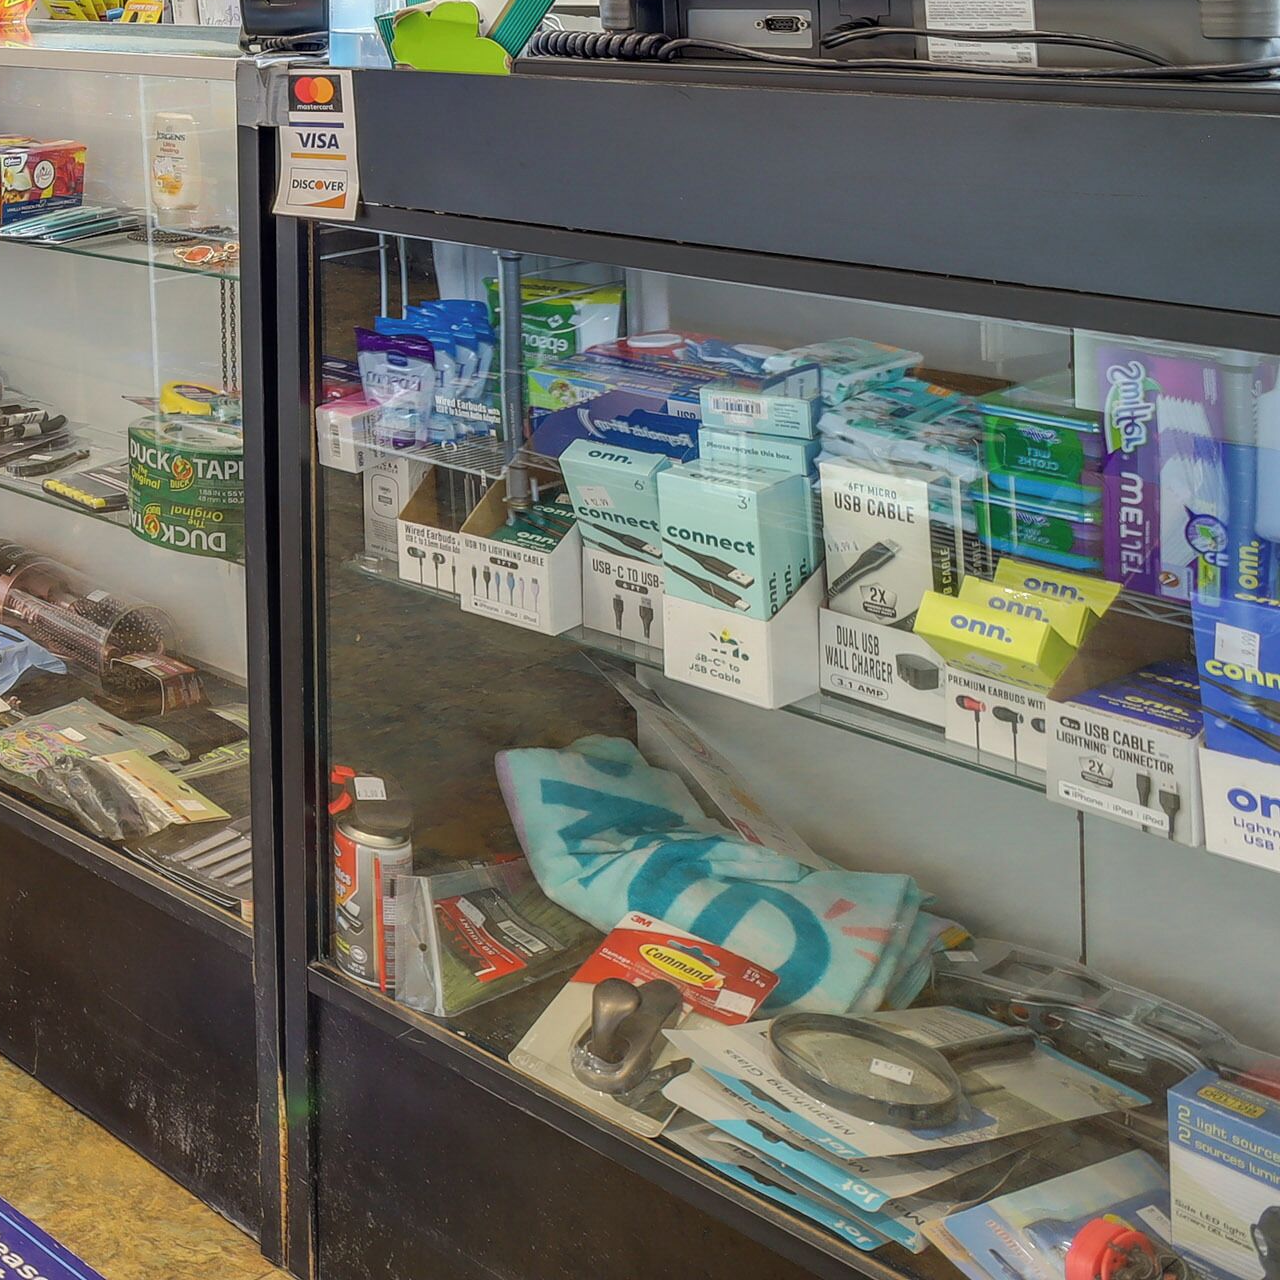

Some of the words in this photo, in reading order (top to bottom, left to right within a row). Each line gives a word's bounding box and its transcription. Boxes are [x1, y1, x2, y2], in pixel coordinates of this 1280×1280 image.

[297, 102, 334, 111] mastercard
[297, 132, 340, 150] VISA
[292, 178, 345, 193] DISCOVER
[130, 438, 171, 473] DUCK
[868, 486, 897, 500] MICRO
[578, 505, 660, 533] connect
[834, 492, 861, 513] USB
[867, 500, 915, 524] CABLE
[465, 539, 477, 549] USB
[489, 544, 521, 559] LIGHTNING
[524, 552, 545, 567] CABLE
[667, 523, 755, 556] connect
[950, 615, 1012, 643] onn.
[826, 645, 849, 671] WALL
[852, 653, 893, 684] CHARGER
[988, 685, 1026, 705] EARBUDS
[1113, 747, 1174, 775] CONNECTOR
[1071, 790, 1104, 808] iPhone
[1112, 804, 1133, 818] iPad
[1143, 811, 1164, 827] iPod
[644, 945, 713, 983] Command
[723, 1048, 763, 1077] Glass
[766, 1077, 856, 1137] Magnifying
[1177, 1104, 1191, 1123] 2
[1196, 1117, 1228, 1140] light
[1195, 1140, 1245, 1169] sources
